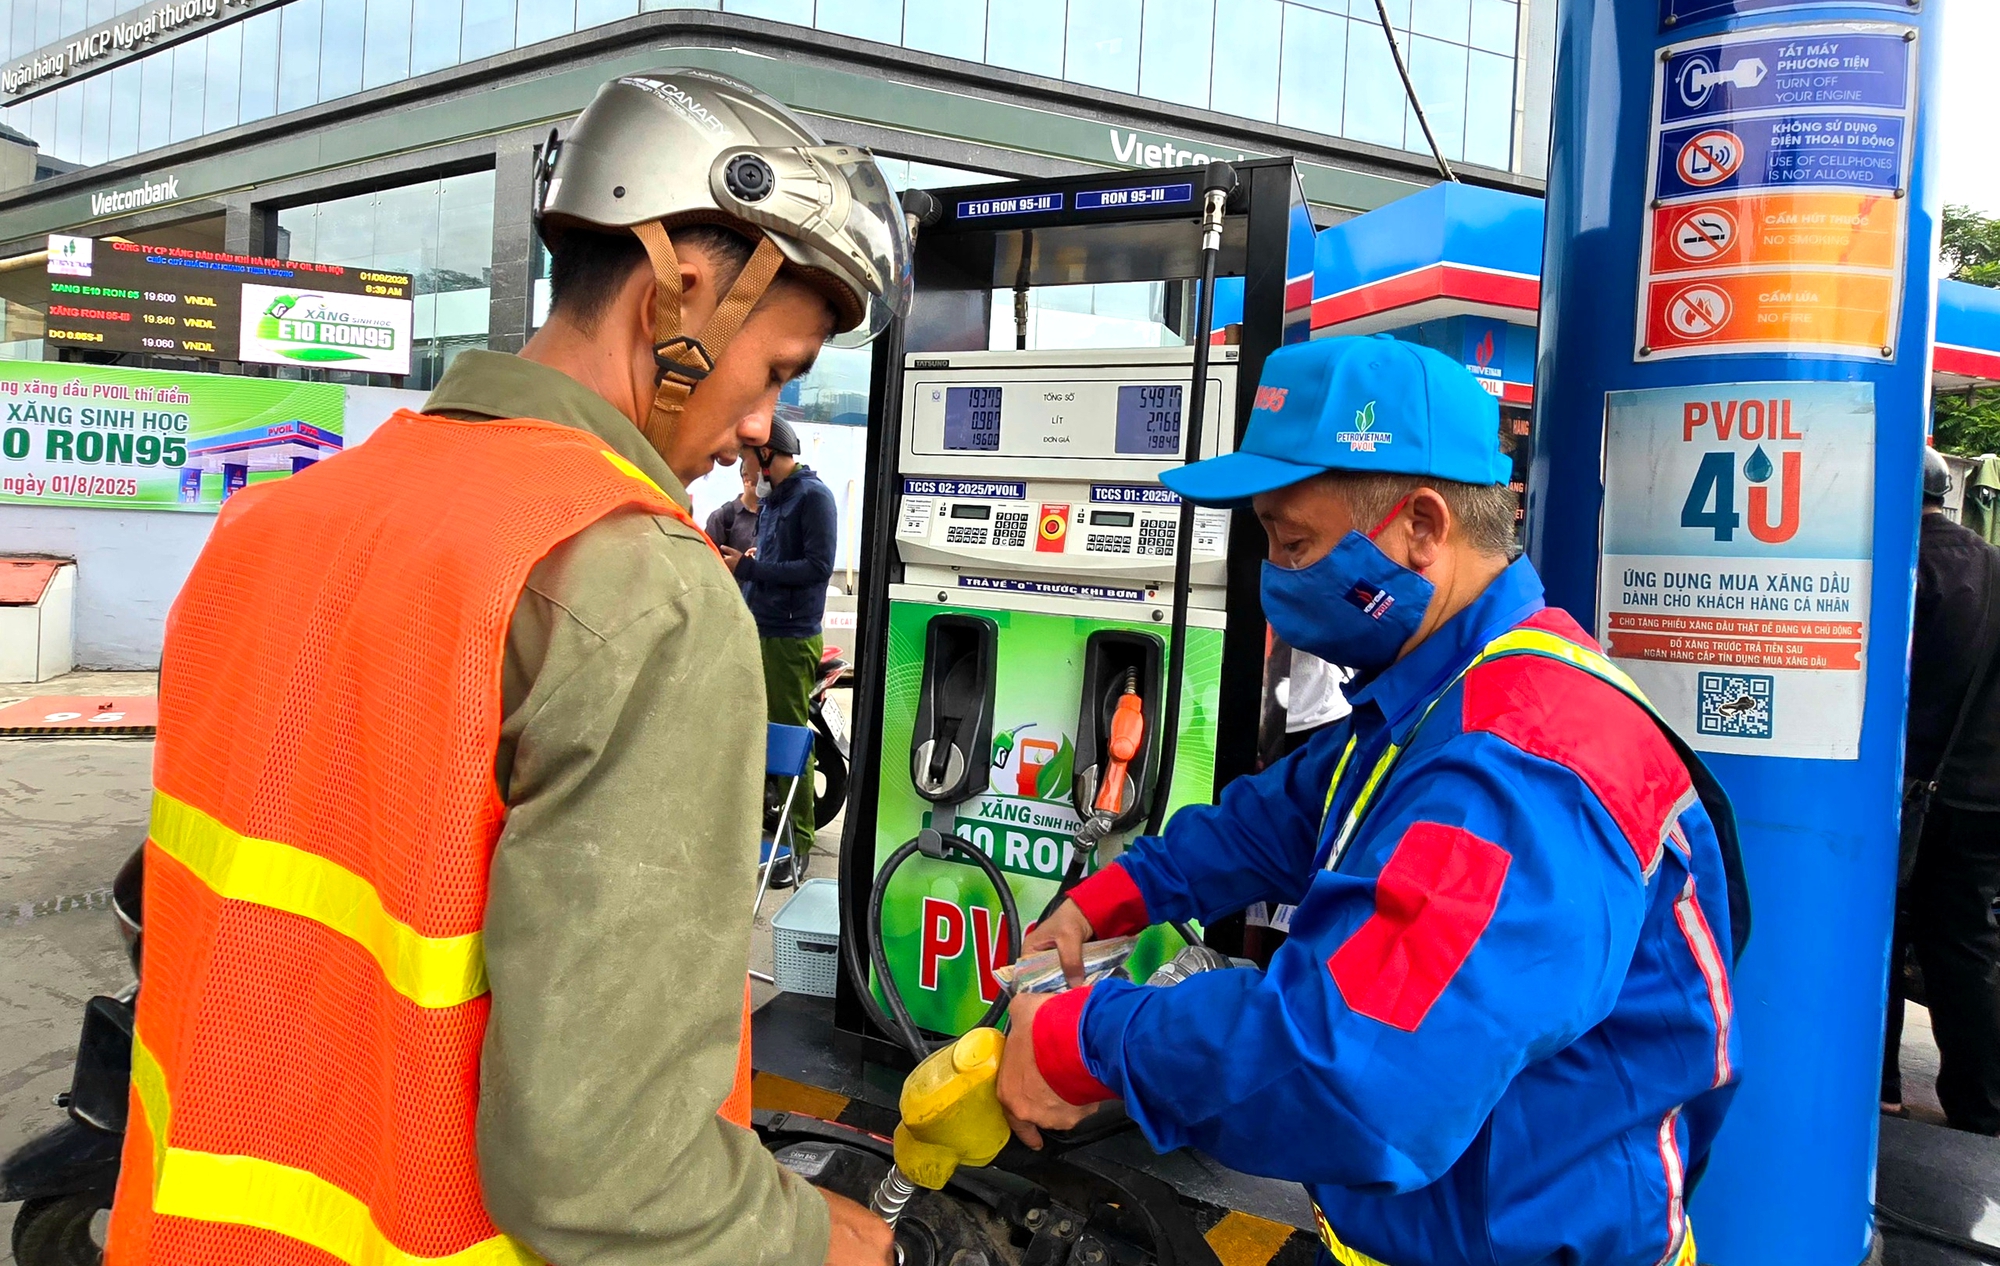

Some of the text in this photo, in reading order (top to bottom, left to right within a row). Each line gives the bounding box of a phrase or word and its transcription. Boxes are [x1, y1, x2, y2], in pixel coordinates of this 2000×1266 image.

[1, 64, 32, 93] Ngân
[33, 53, 64, 79] hàng
[66, 30, 111, 65] TMCP
[113, 11, 157, 48] Ngoại
[1778, 42, 1840, 58] TẮT MÁY
[1777, 55, 1870, 71] PHƯƠNG TIỆN
[1775, 76, 1839, 90] TURN OFF
[1775, 90, 1862, 103] YOUR ENGINE
[660, 83, 736, 138] CANARY
[1772, 119, 1877, 134] KHÔNG SỬ DỤNG
[1770, 134, 1895, 149] ĐIỆN THOẠI DI ĐỘNG
[1769, 155, 1893, 170] USE OF CELLPHONES
[1769, 169, 1874, 181] IS NOT ALLOWED
[91, 174, 179, 216] Vietcombank
[1101, 188, 1165, 205] RON 95-III
[968, 197, 1051, 216] E10 RON 95-III
[1765, 210, 1798, 225] CẤM
[1801, 212, 1827, 224] HÚT
[1763, 234, 1850, 246] NO SMOKING
[143, 291, 176, 303] 19.600
[387, 287, 402, 296] AM
[1758, 289, 1792, 303] CẤM
[142, 314, 175, 326] 19.840
[304, 305, 350, 323] XĂNG
[1757, 312, 1813, 323] NO FIRE
[278, 319, 392, 349] E10 RON95
[141, 338, 175, 349] 19.060
[24, 380, 58, 399] xăng
[63, 380, 88, 398] dầu
[93, 384, 130, 401] PVOIL
[134, 386, 154, 402] thí
[157, 386, 190, 405] điểm
[7, 401, 189, 436] XĂNG SINH HỌC
[1051, 416, 1064, 425] LÍT
[1683, 399, 1803, 442] PVOIL
[268, 425, 294, 437] PVOIL
[1337, 432, 1391, 443] PETROVIETNAM
[45, 430, 188, 467] RON95
[1350, 441, 1376, 451] PVOIL
[3, 474, 137, 497] ngày 01/8/2025
[909, 481, 1019, 497] TCCS 02: 2025/PVOIL
[1095, 488, 1122, 501] TCCS
[1123, 489, 1140, 501] 01:
[1680, 451, 1802, 544] 4U
[1623, 568, 1850, 594] ỨNG DỤNG MUA XĂNG DẦU
[1035, 582, 1078, 594] TRƯỚC
[1080, 586, 1104, 596] KHI
[1106, 589, 1138, 599] BƠM
[1622, 591, 1850, 613] DÀNH CHO KHÁCH HÀNG CÁ NHÂN
[1619, 616, 1636, 626] CHO
[1689, 619, 1714, 631] XĂNG
[1775, 623, 1799, 635] DÀNG
[1801, 623, 1813, 635] VÀ
[1832, 624, 1853, 637] ĐỘNG
[1685, 639, 1710, 651] XĂNG
[1785, 643, 1804, 655] SAU
[1735, 652, 1760, 665] DỤNG
[1762, 654, 1783, 665] MUA
[1785, 655, 1809, 667] XĂNG
[42, 711, 126, 723] 95
[978, 798, 1061, 830] XĂNG SINH
